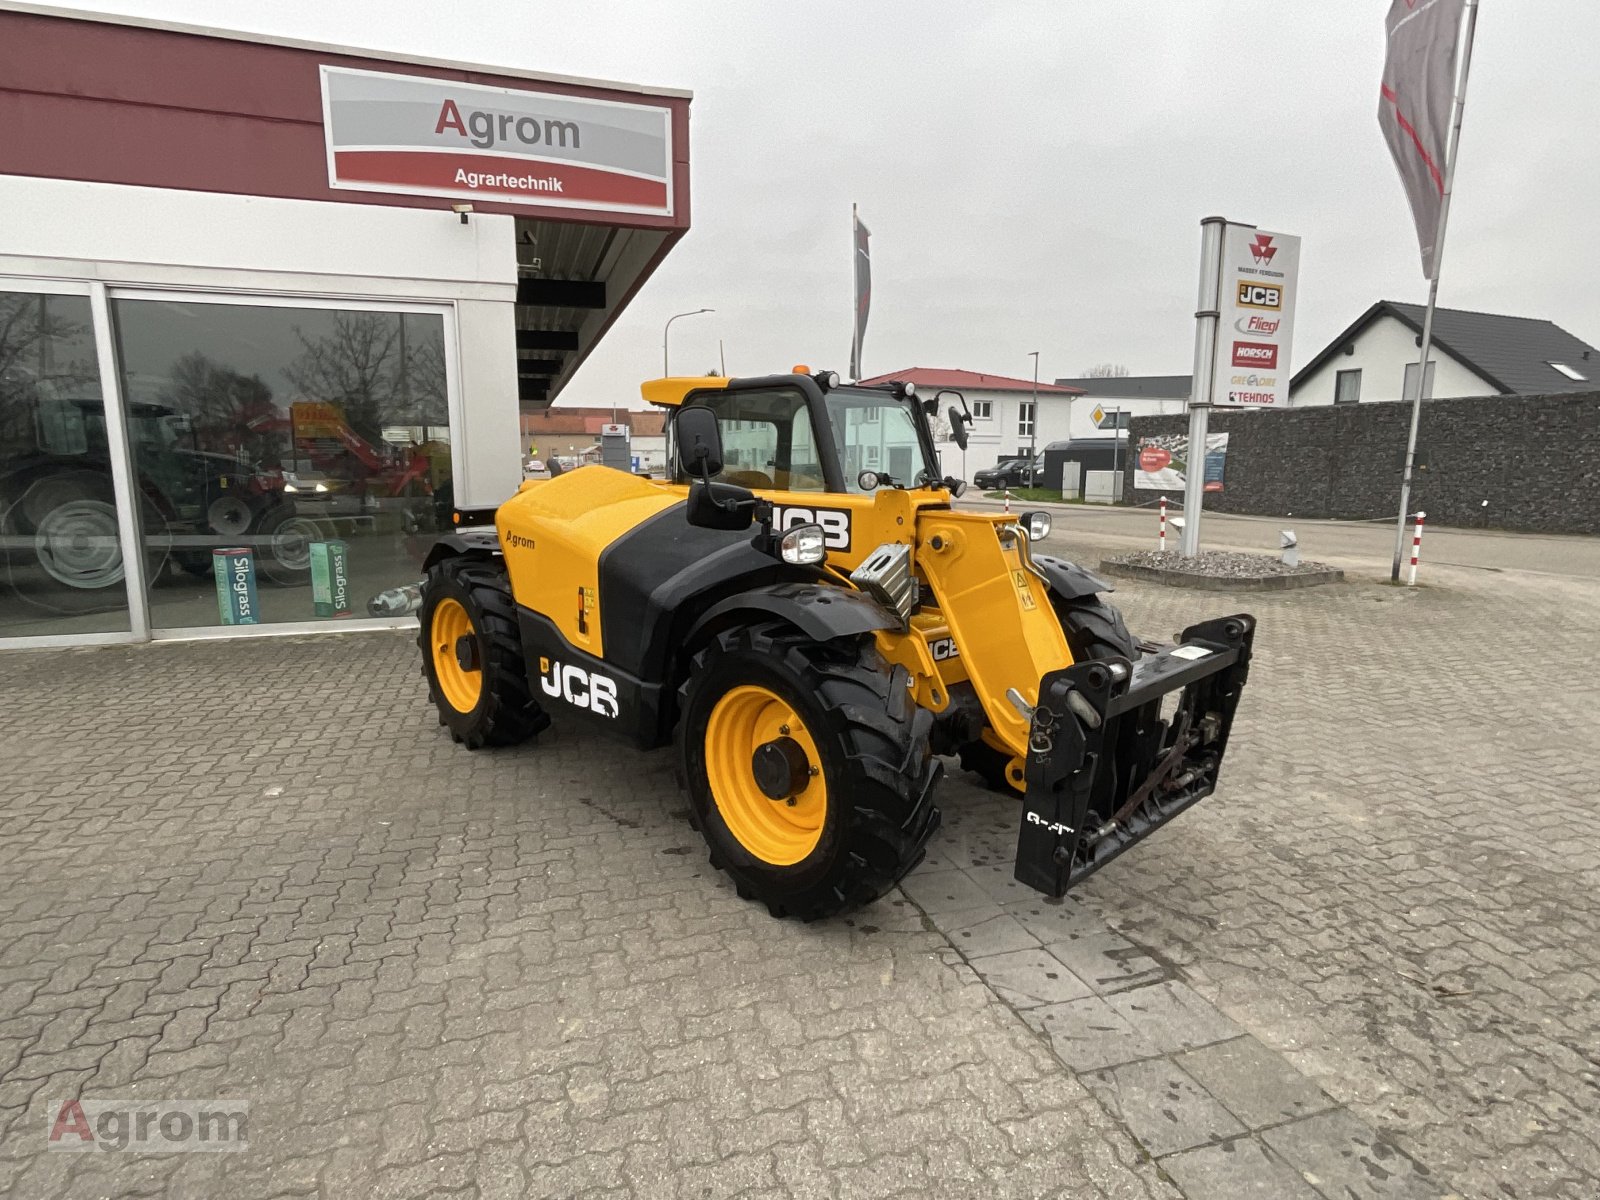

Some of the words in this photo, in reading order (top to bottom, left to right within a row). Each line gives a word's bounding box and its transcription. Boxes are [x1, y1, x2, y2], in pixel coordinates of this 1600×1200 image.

[435, 99, 580, 149] Agrom
[455, 168, 563, 192] Agrartechnik
[1238, 266, 1258, 274] MASSEY
[1240, 286, 1279, 306] JCB
[1248, 316, 1280, 335] Fliegl
[1237, 347, 1273, 359] HORSCH
[1238, 391, 1274, 403] TEHNOS
[506, 530, 535, 549] Agrom
[233, 557, 250, 616] Silograss
[334, 555, 347, 609] Silograss
[541, 661, 619, 718] JCB
